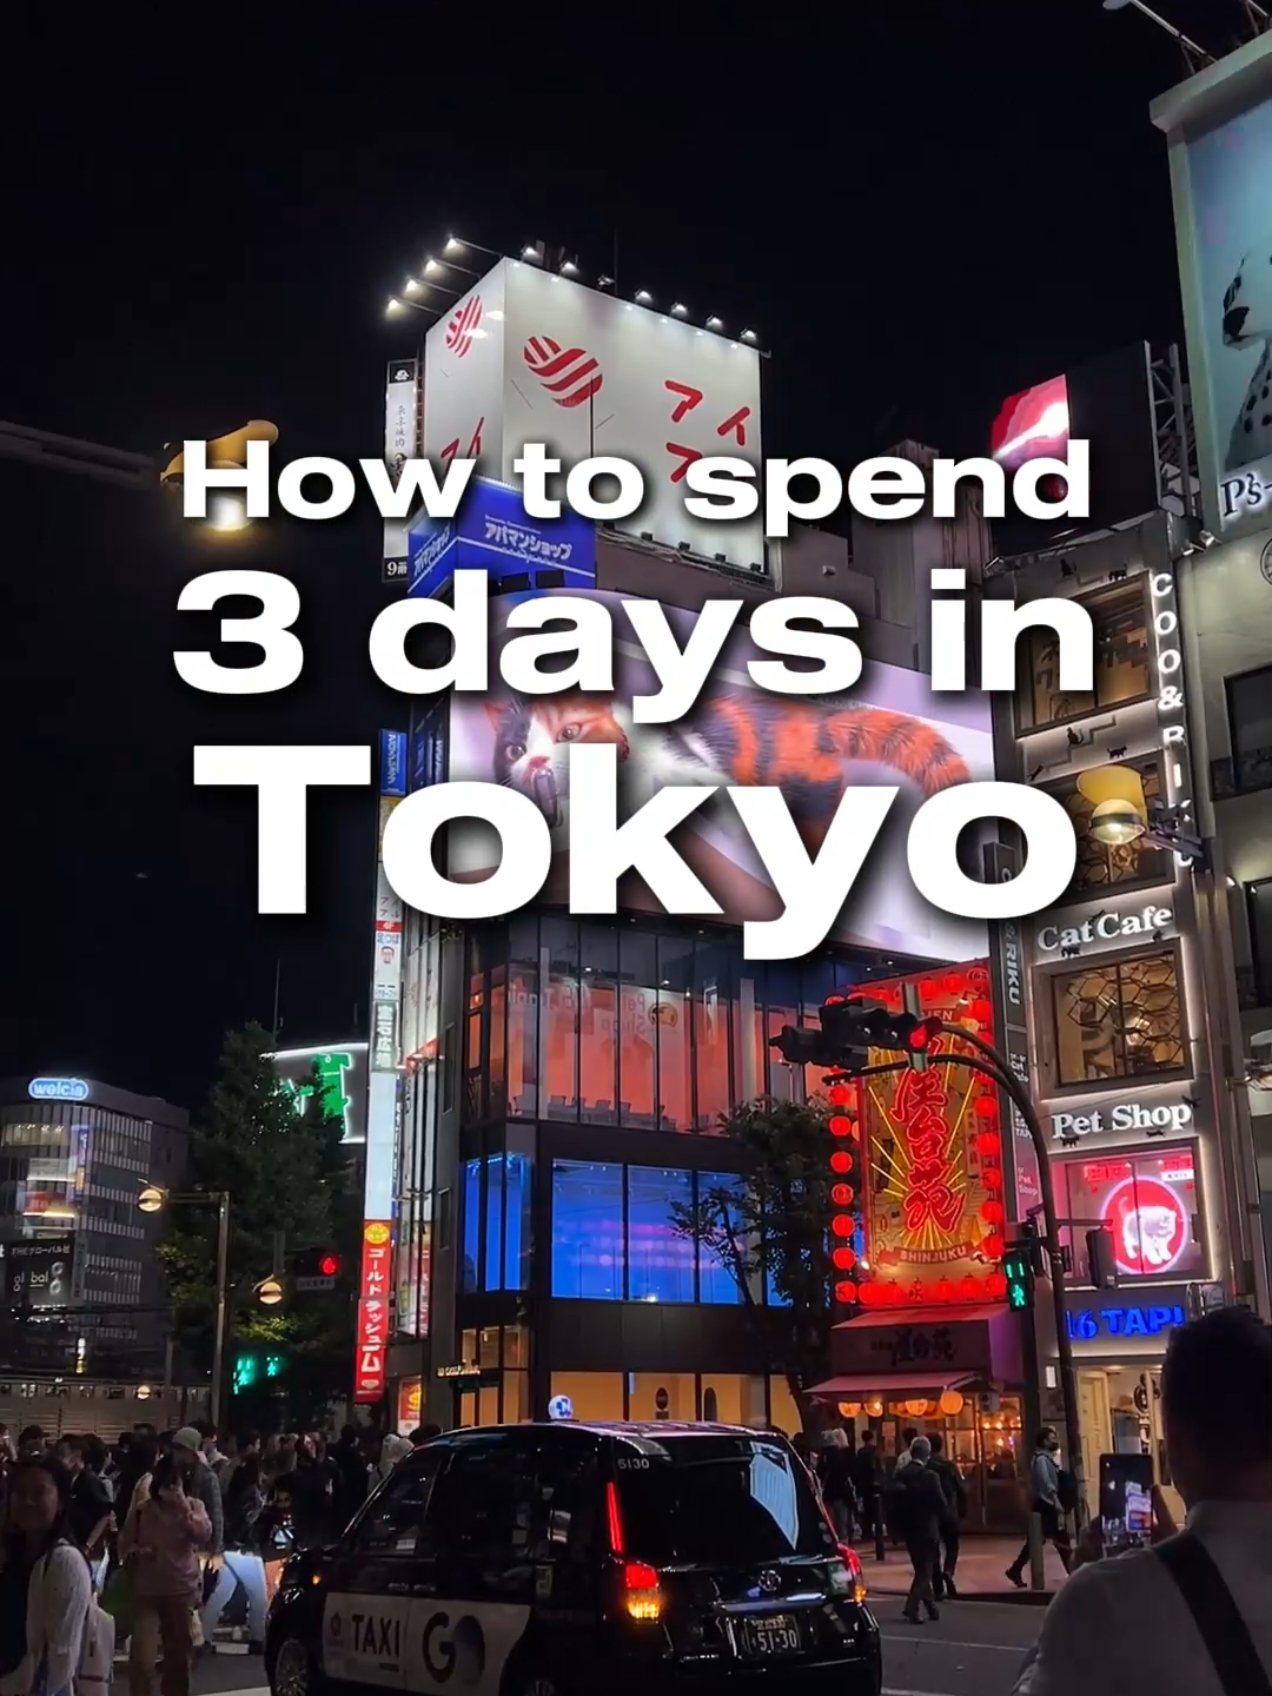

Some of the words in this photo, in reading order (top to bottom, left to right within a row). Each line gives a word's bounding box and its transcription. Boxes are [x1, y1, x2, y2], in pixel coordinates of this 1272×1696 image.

[485, 522, 573, 561] アパマンショップ
[1038, 919, 1094, 950] Cat
[1097, 905, 1172, 938] Cafe
[1052, 1110, 1104, 1139] Pet
[1112, 1103, 1192, 1131] Shop
[899, 1245, 967, 1262] SHINJUKU
[616, 1457, 651, 1471] 5130
[351, 1614, 401, 1658] TAXI
[422, 1611, 486, 1685] GO
